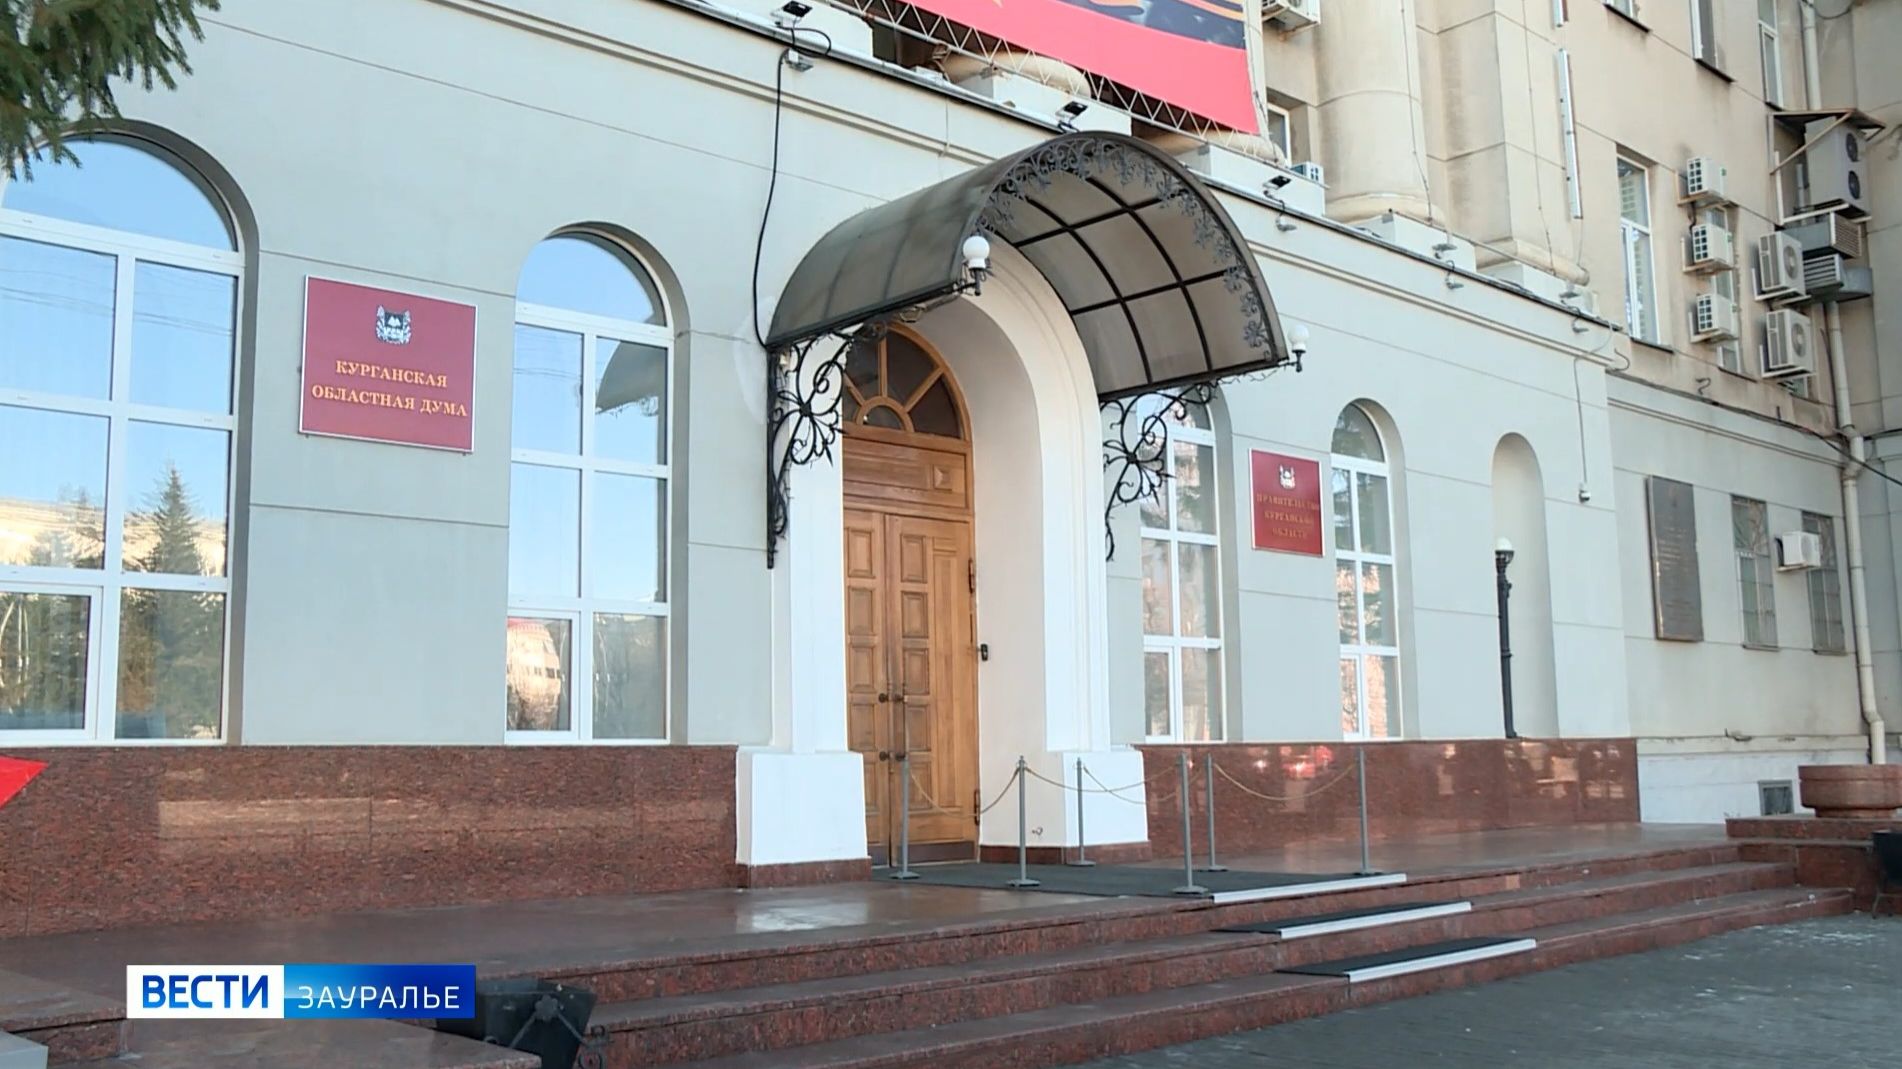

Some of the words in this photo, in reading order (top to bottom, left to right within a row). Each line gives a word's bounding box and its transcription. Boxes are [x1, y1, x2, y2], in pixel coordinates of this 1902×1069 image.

[336, 360, 447, 387] КУРГАНСКАЯ
[312, 385, 415, 410] ОБЛАСТНАЯ
[420, 399, 467, 417] ДУМА
